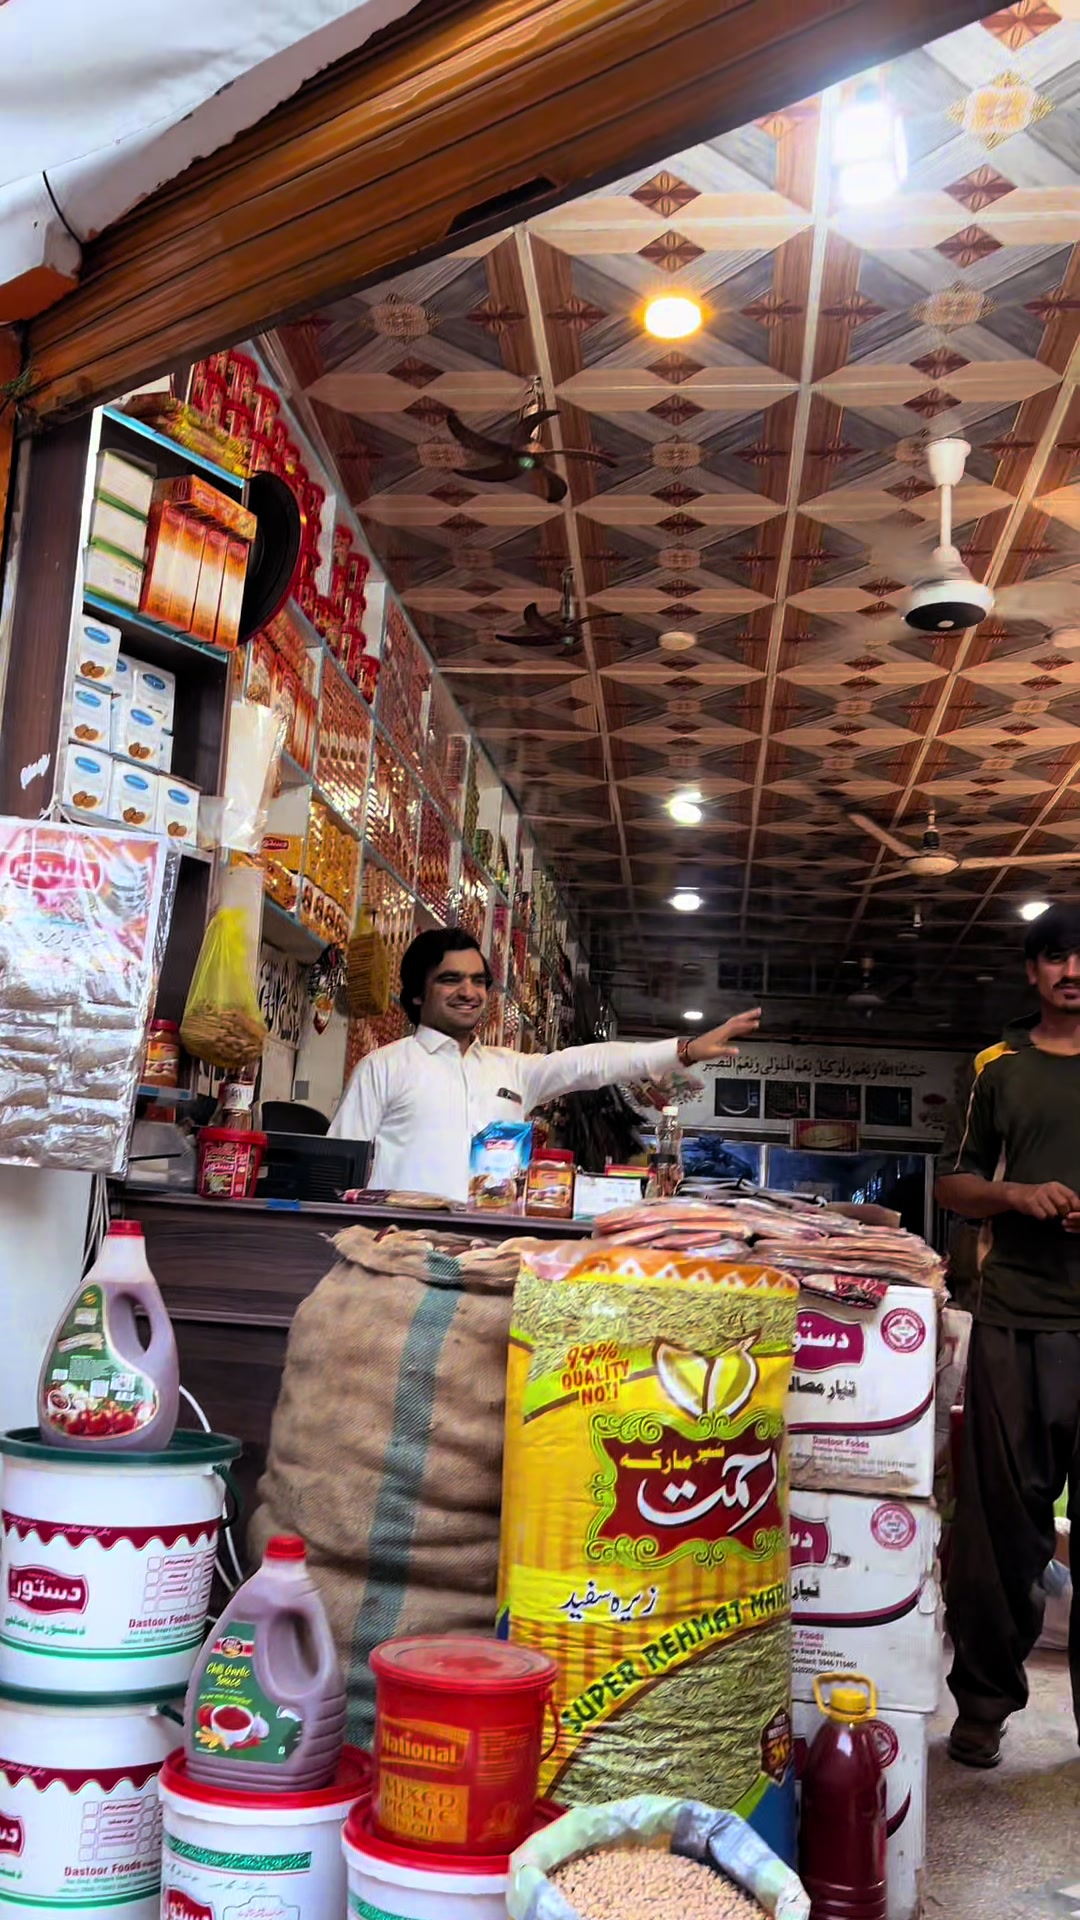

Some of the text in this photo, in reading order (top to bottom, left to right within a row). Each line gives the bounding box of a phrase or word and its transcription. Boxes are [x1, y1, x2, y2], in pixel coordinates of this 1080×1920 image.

[791, 1321, 850, 1353] دستو
[561, 1358, 630, 1391] QUALITY
[636, 1447, 778, 1536] رحمت
[10, 1578, 82, 1602] دستور
[128, 1618, 167, 1628] Dastoor
[224, 1664, 251, 1678] Garlic
[560, 1582, 788, 1734] SUPER REHMAT MAR
[215, 1674, 242, 1687] Sauce
[385, 1774, 456, 1809] MIXED
[384, 1796, 451, 1824] PICKLE
[64, 1859, 142, 1877] Dastoor Foods
